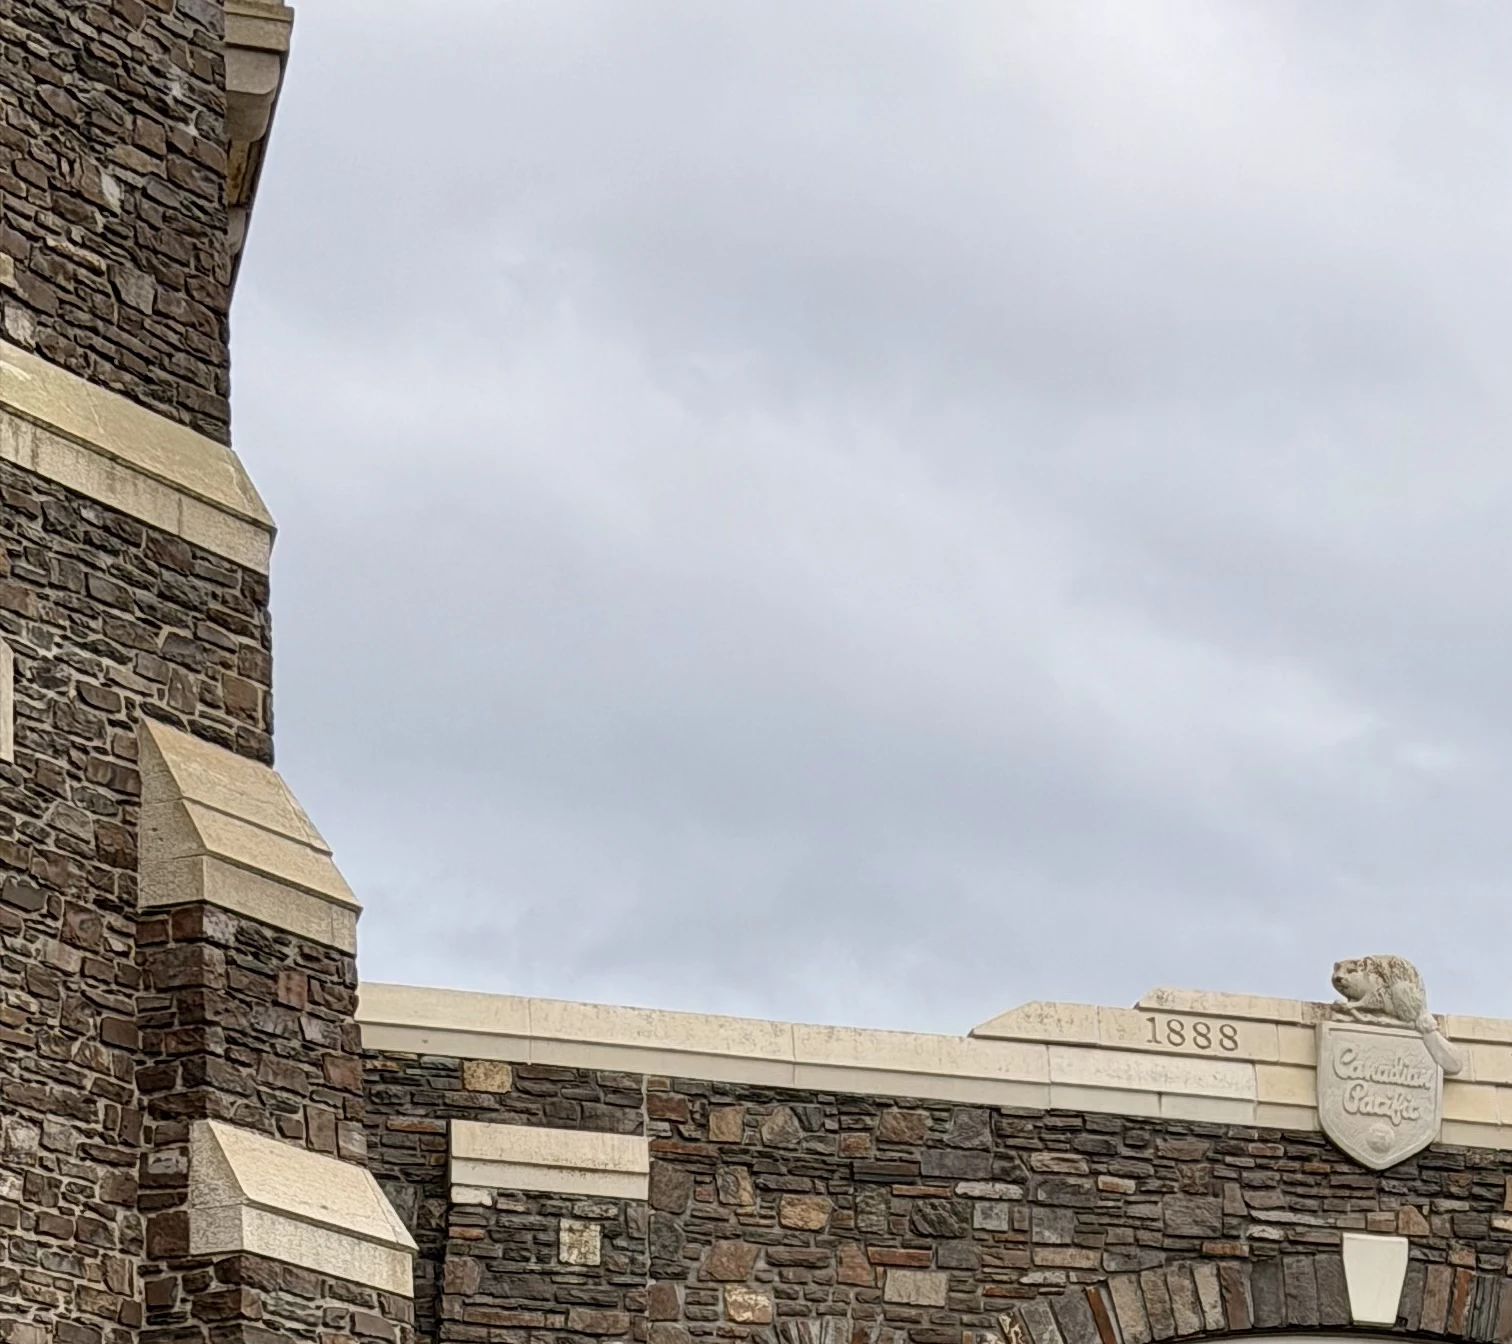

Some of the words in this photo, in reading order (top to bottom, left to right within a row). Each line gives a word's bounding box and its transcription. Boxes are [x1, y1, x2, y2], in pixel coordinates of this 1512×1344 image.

[1146, 1016, 1239, 1052] 1888
[1332, 1044, 1431, 1091] Canadian
[1343, 1083, 1420, 1128] Pacific
